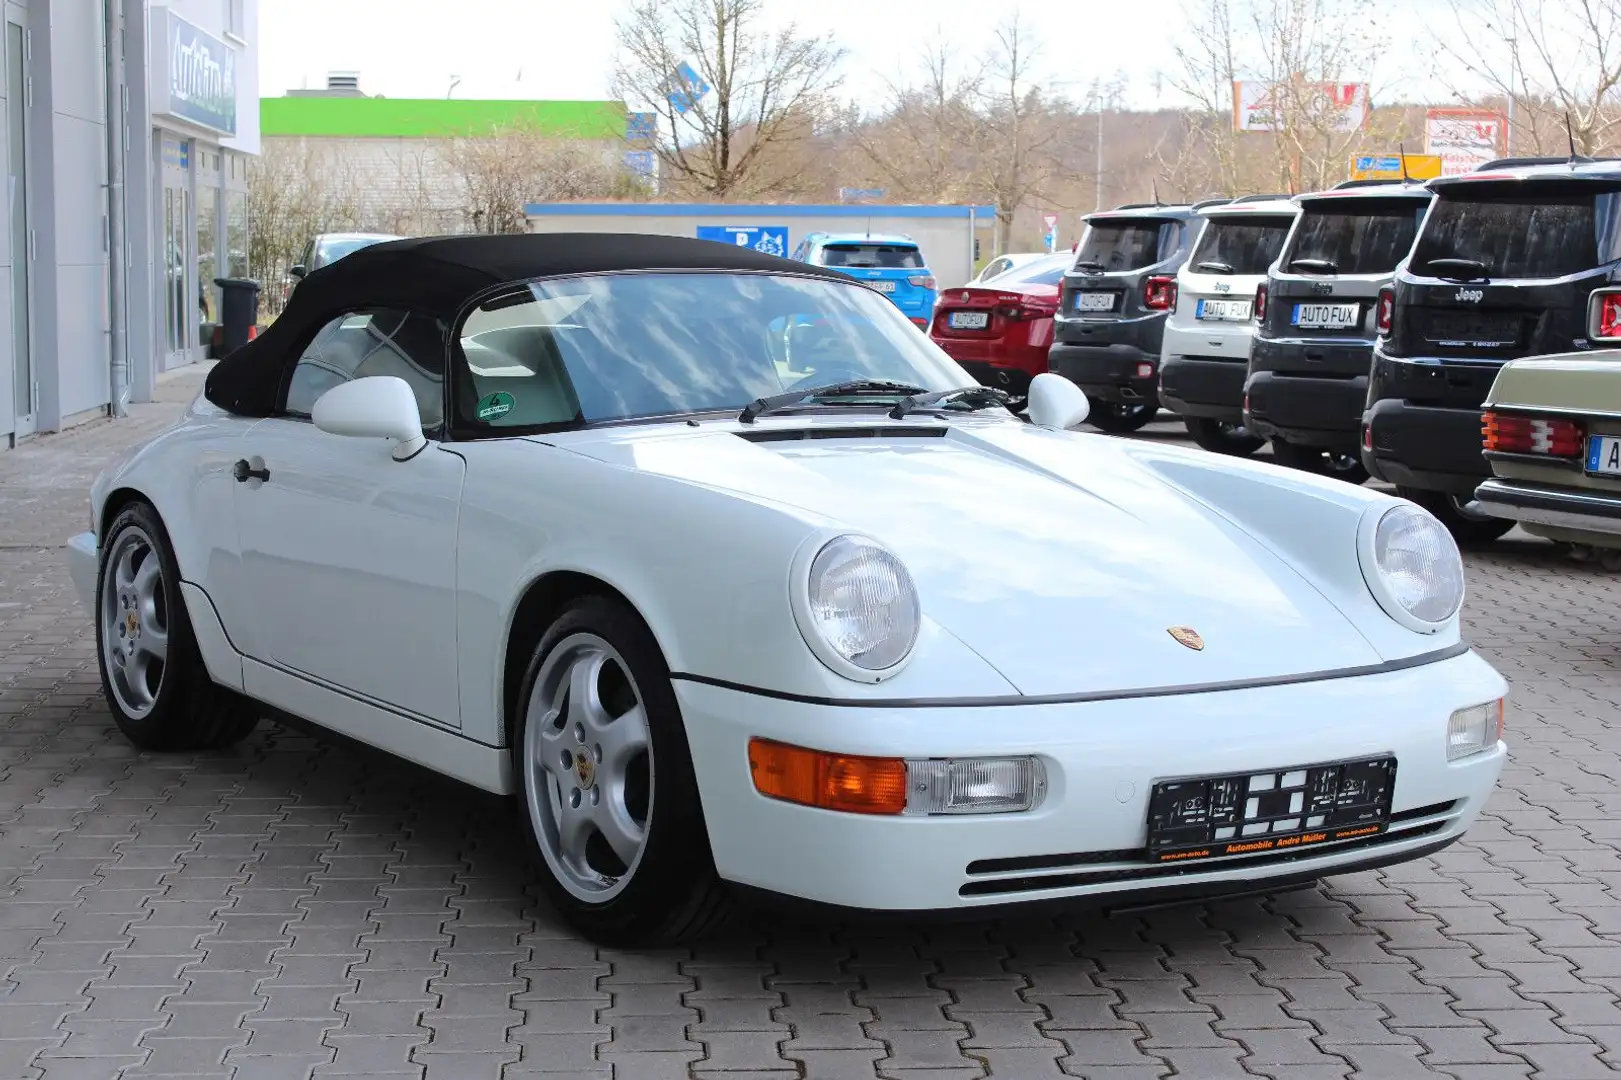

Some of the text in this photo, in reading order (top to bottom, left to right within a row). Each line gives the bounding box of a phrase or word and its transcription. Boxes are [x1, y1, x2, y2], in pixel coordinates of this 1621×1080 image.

[1455, 287, 1484, 303] Jeep
[1204, 302, 1250, 317] AUTO FUX
[1301, 306, 1354, 323] AUTO FUX
[489, 392, 500, 406] 4
[1226, 839, 1273, 854] Automobile
[1302, 832, 1328, 844] Müller
